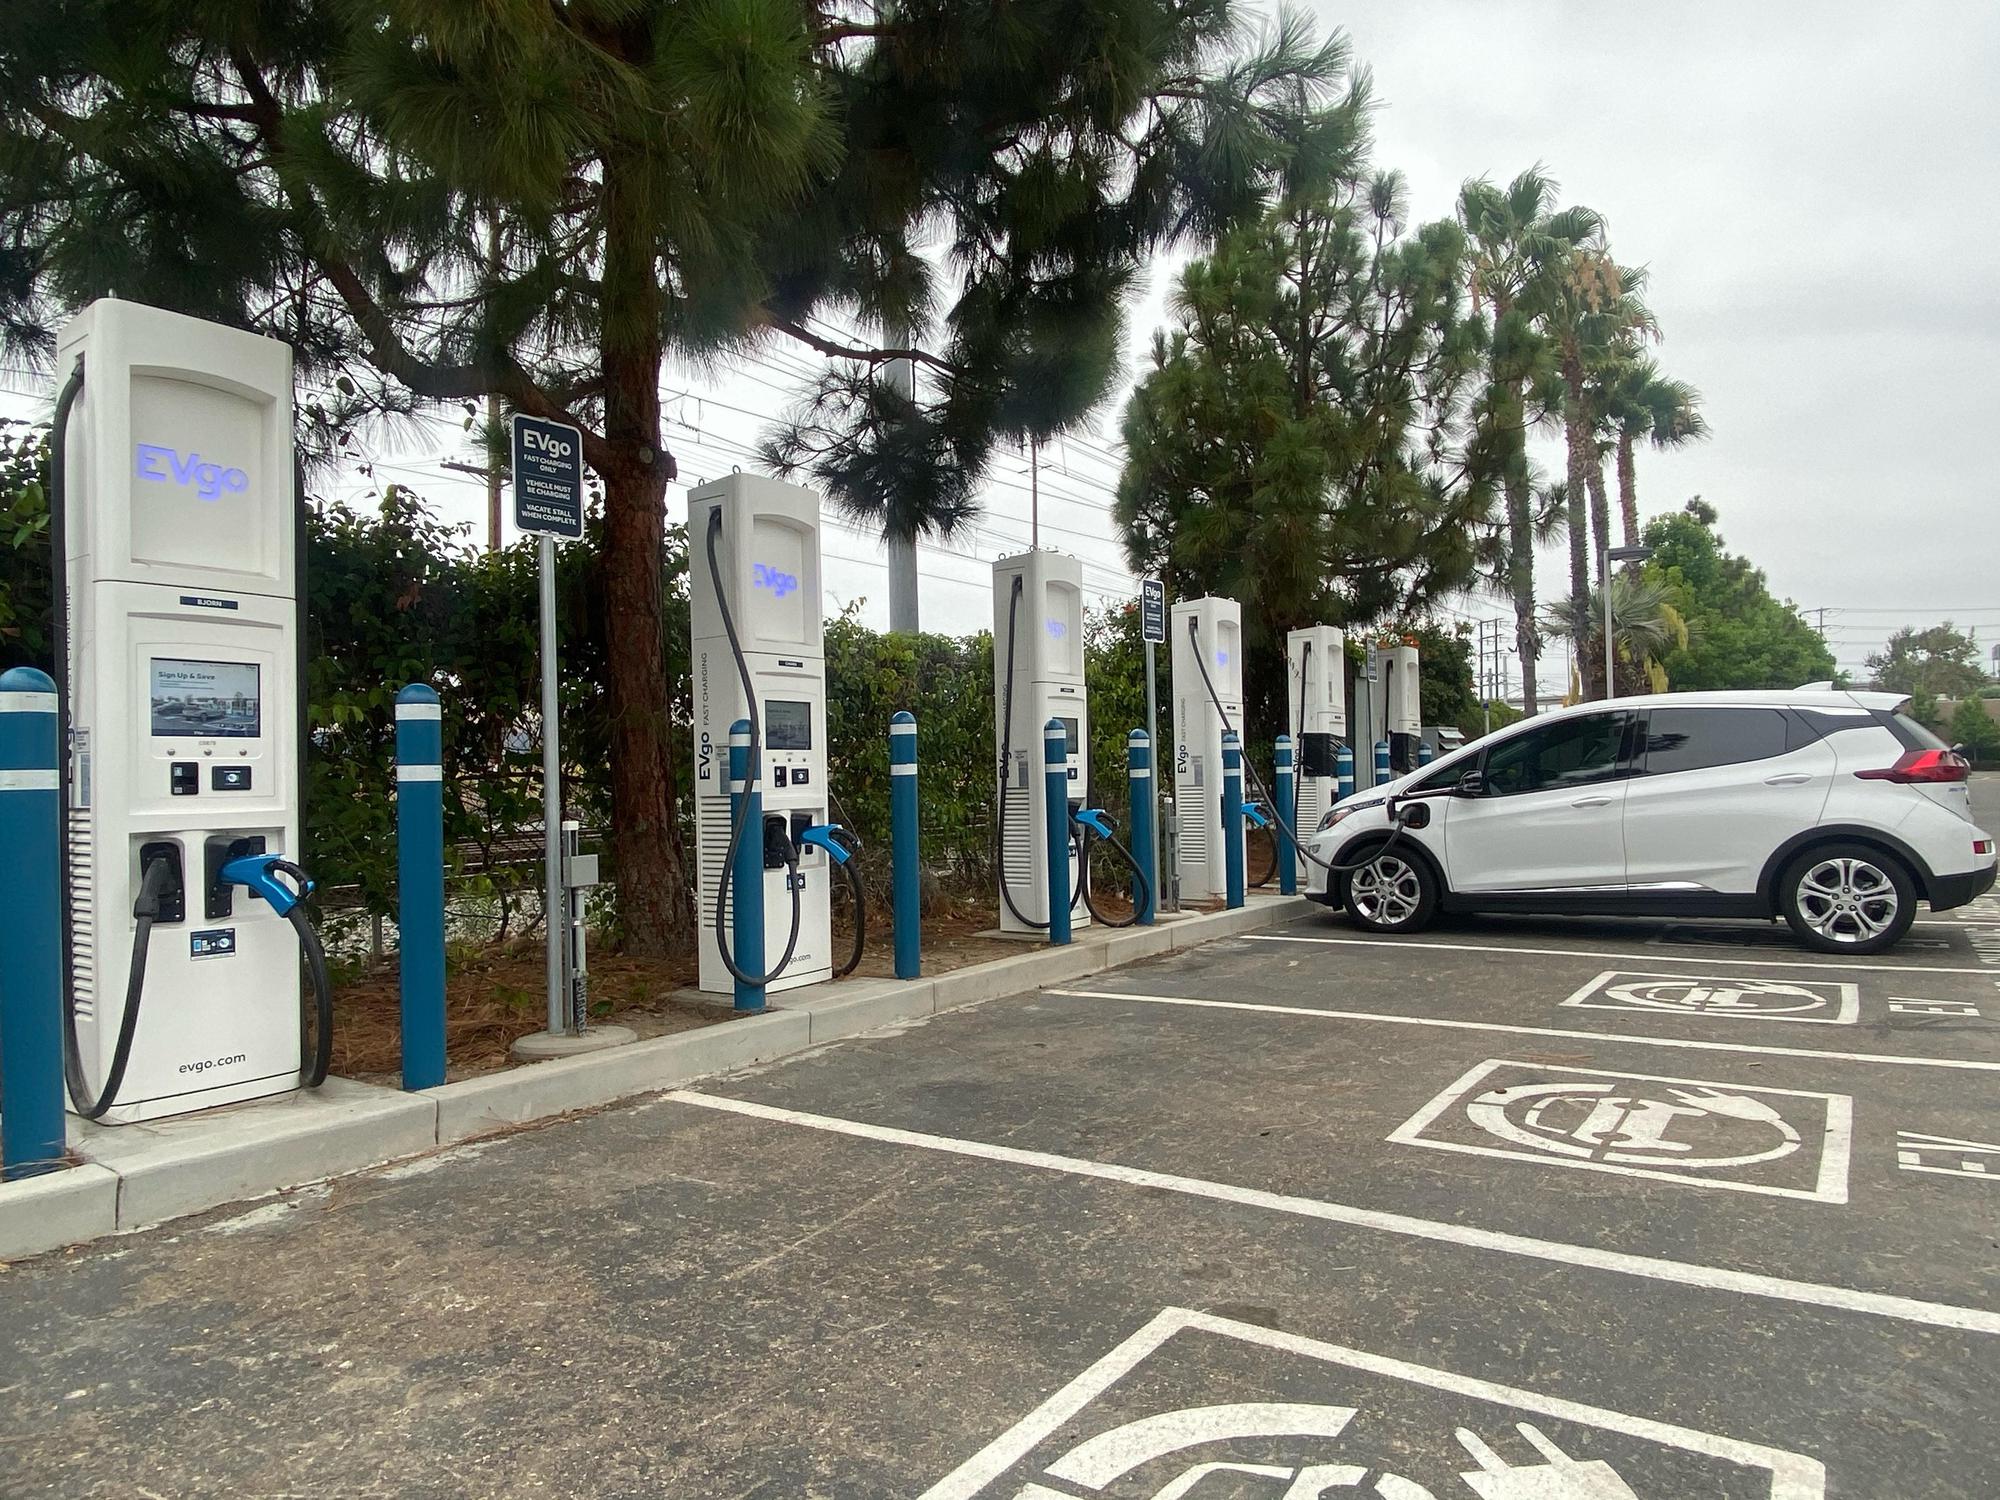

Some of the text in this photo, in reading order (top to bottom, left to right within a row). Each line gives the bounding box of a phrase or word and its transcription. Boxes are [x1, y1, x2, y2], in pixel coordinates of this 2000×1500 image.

[523, 428, 572, 459] EVgo
[523, 454, 572, 470] FAST CHARGING
[539, 465, 557, 474] ONLY
[136, 443, 249, 501] EVgo
[525, 478, 571, 493] VEHICLE MUST
[536, 488, 571, 501] CHARGING
[522, 510, 577, 526] WHEN COMPLETE
[526, 503, 572, 518] VACATE STALL
[1145, 586, 1161, 601] EVgo
[197, 598, 223, 607] BJORN
[158, 671, 176, 680] Sign
[176, 672, 189, 680] Up
[701, 652, 709, 702] CHARGING
[699, 731, 713, 780] EVgo
[1177, 744, 1189, 774] EVgo
[178, 1053, 247, 1074] evgo.com
